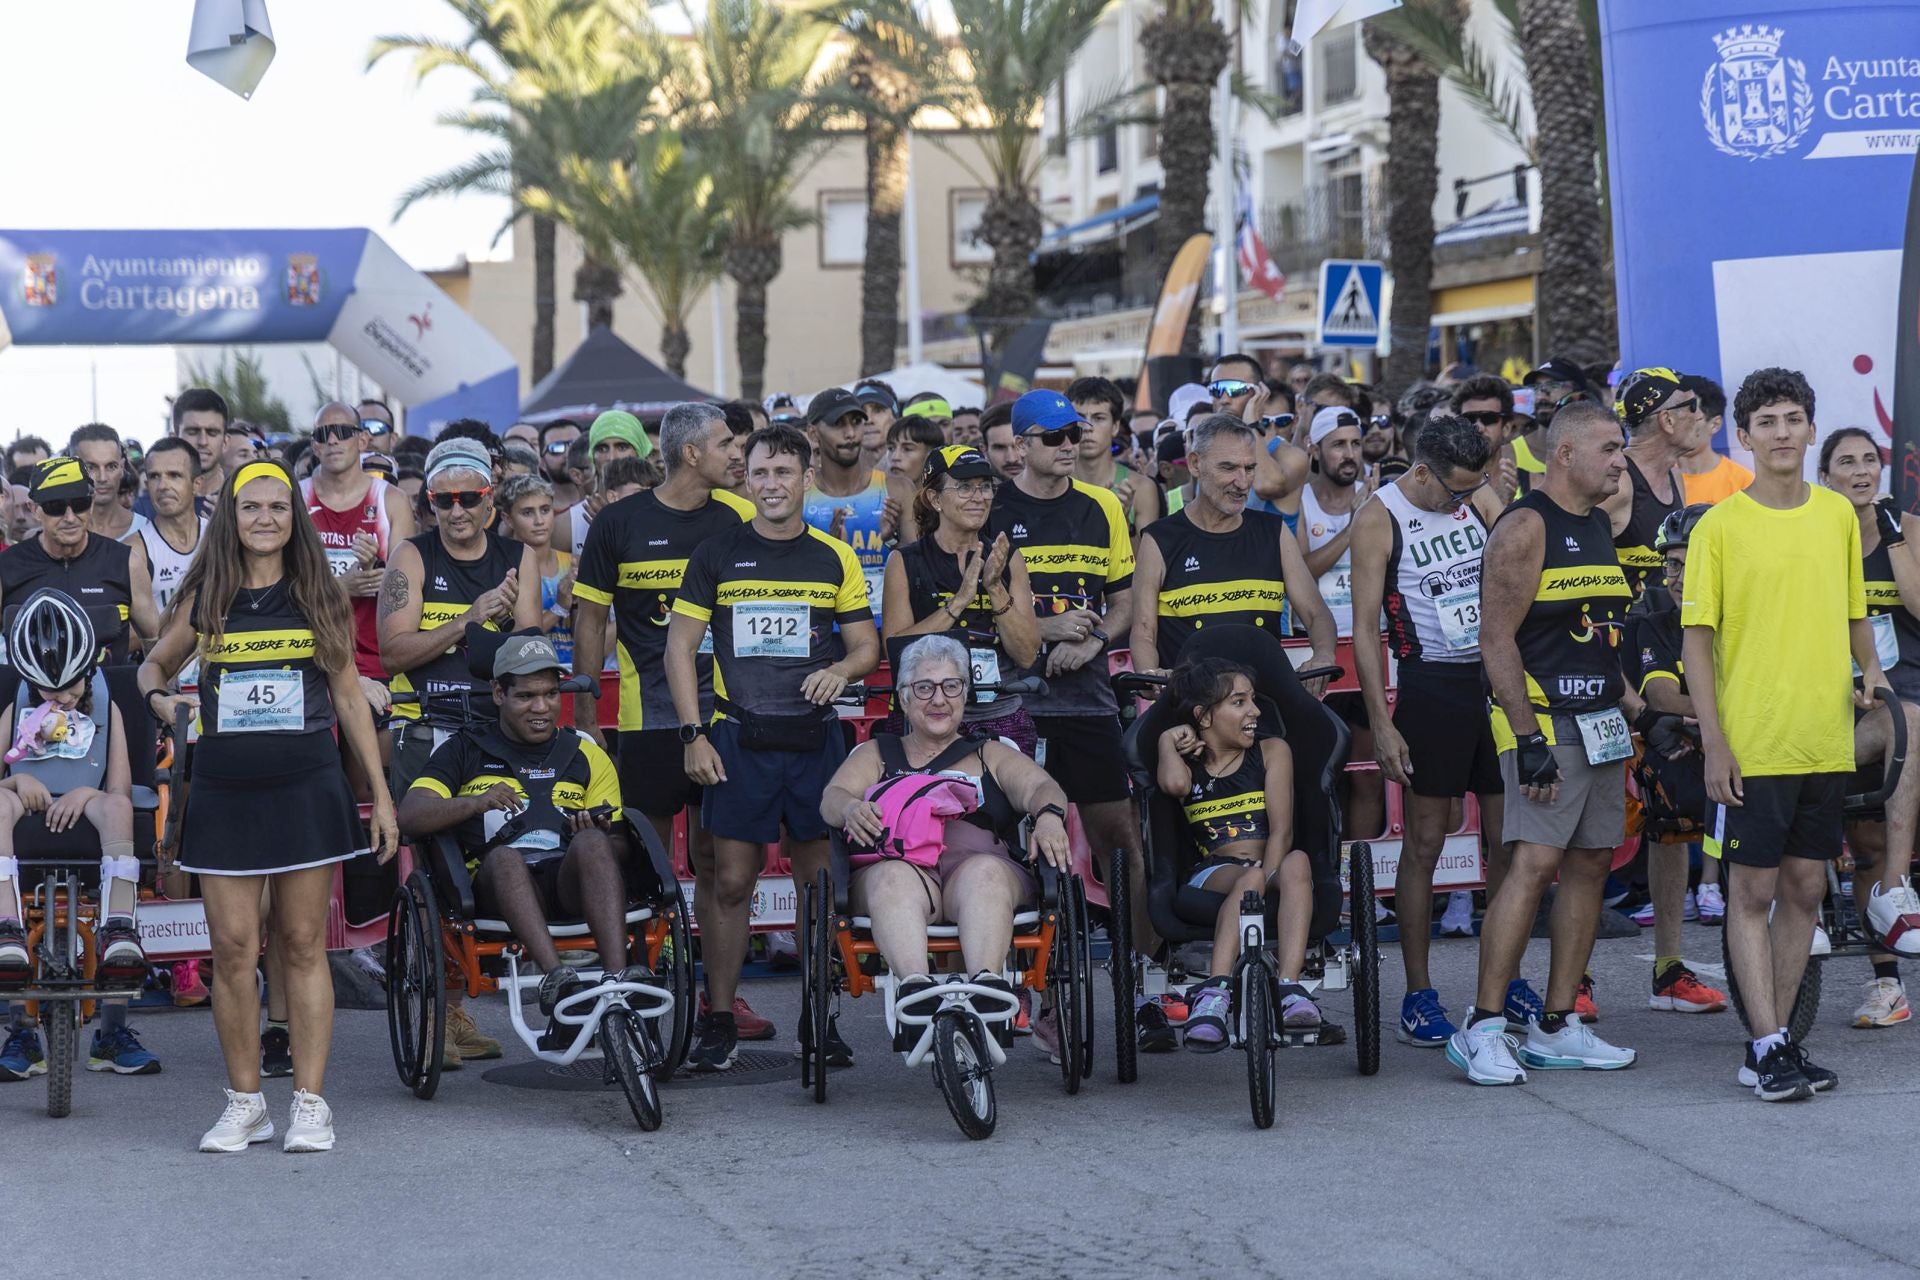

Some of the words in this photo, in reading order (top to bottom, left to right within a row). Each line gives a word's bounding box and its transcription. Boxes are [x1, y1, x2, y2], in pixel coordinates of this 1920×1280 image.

[1822, 55, 1920, 86] Ayunta
[1823, 85, 1920, 121] Carta
[80, 254, 262, 281] Ayuntamiento
[79, 278, 262, 317] Cartagena
[319, 531, 345, 547] RTAS
[852, 529, 884, 553] AM
[1409, 524, 1485, 569] UNED
[1024, 554, 1044, 565] DAS
[1043, 552, 1079, 564] SOBRE
[625, 568, 682, 582] ZANCADAS
[1546, 574, 1602, 591] ZANCADAS
[718, 588, 769, 600] ZANCADAS
[767, 588, 806, 599] SOBRE
[1167, 592, 1218, 610] ZANCADAS
[1218, 589, 1256, 603] SOBRE
[1453, 603, 1481, 626] 13
[747, 616, 798, 636] 1212
[240, 639, 285, 653] SOBRE
[247, 684, 276, 705] 45
[1558, 679, 1606, 696] UPCT
[233, 707, 293, 717] SCHEHERAZADE
[1593, 716, 1625, 741] 1366
